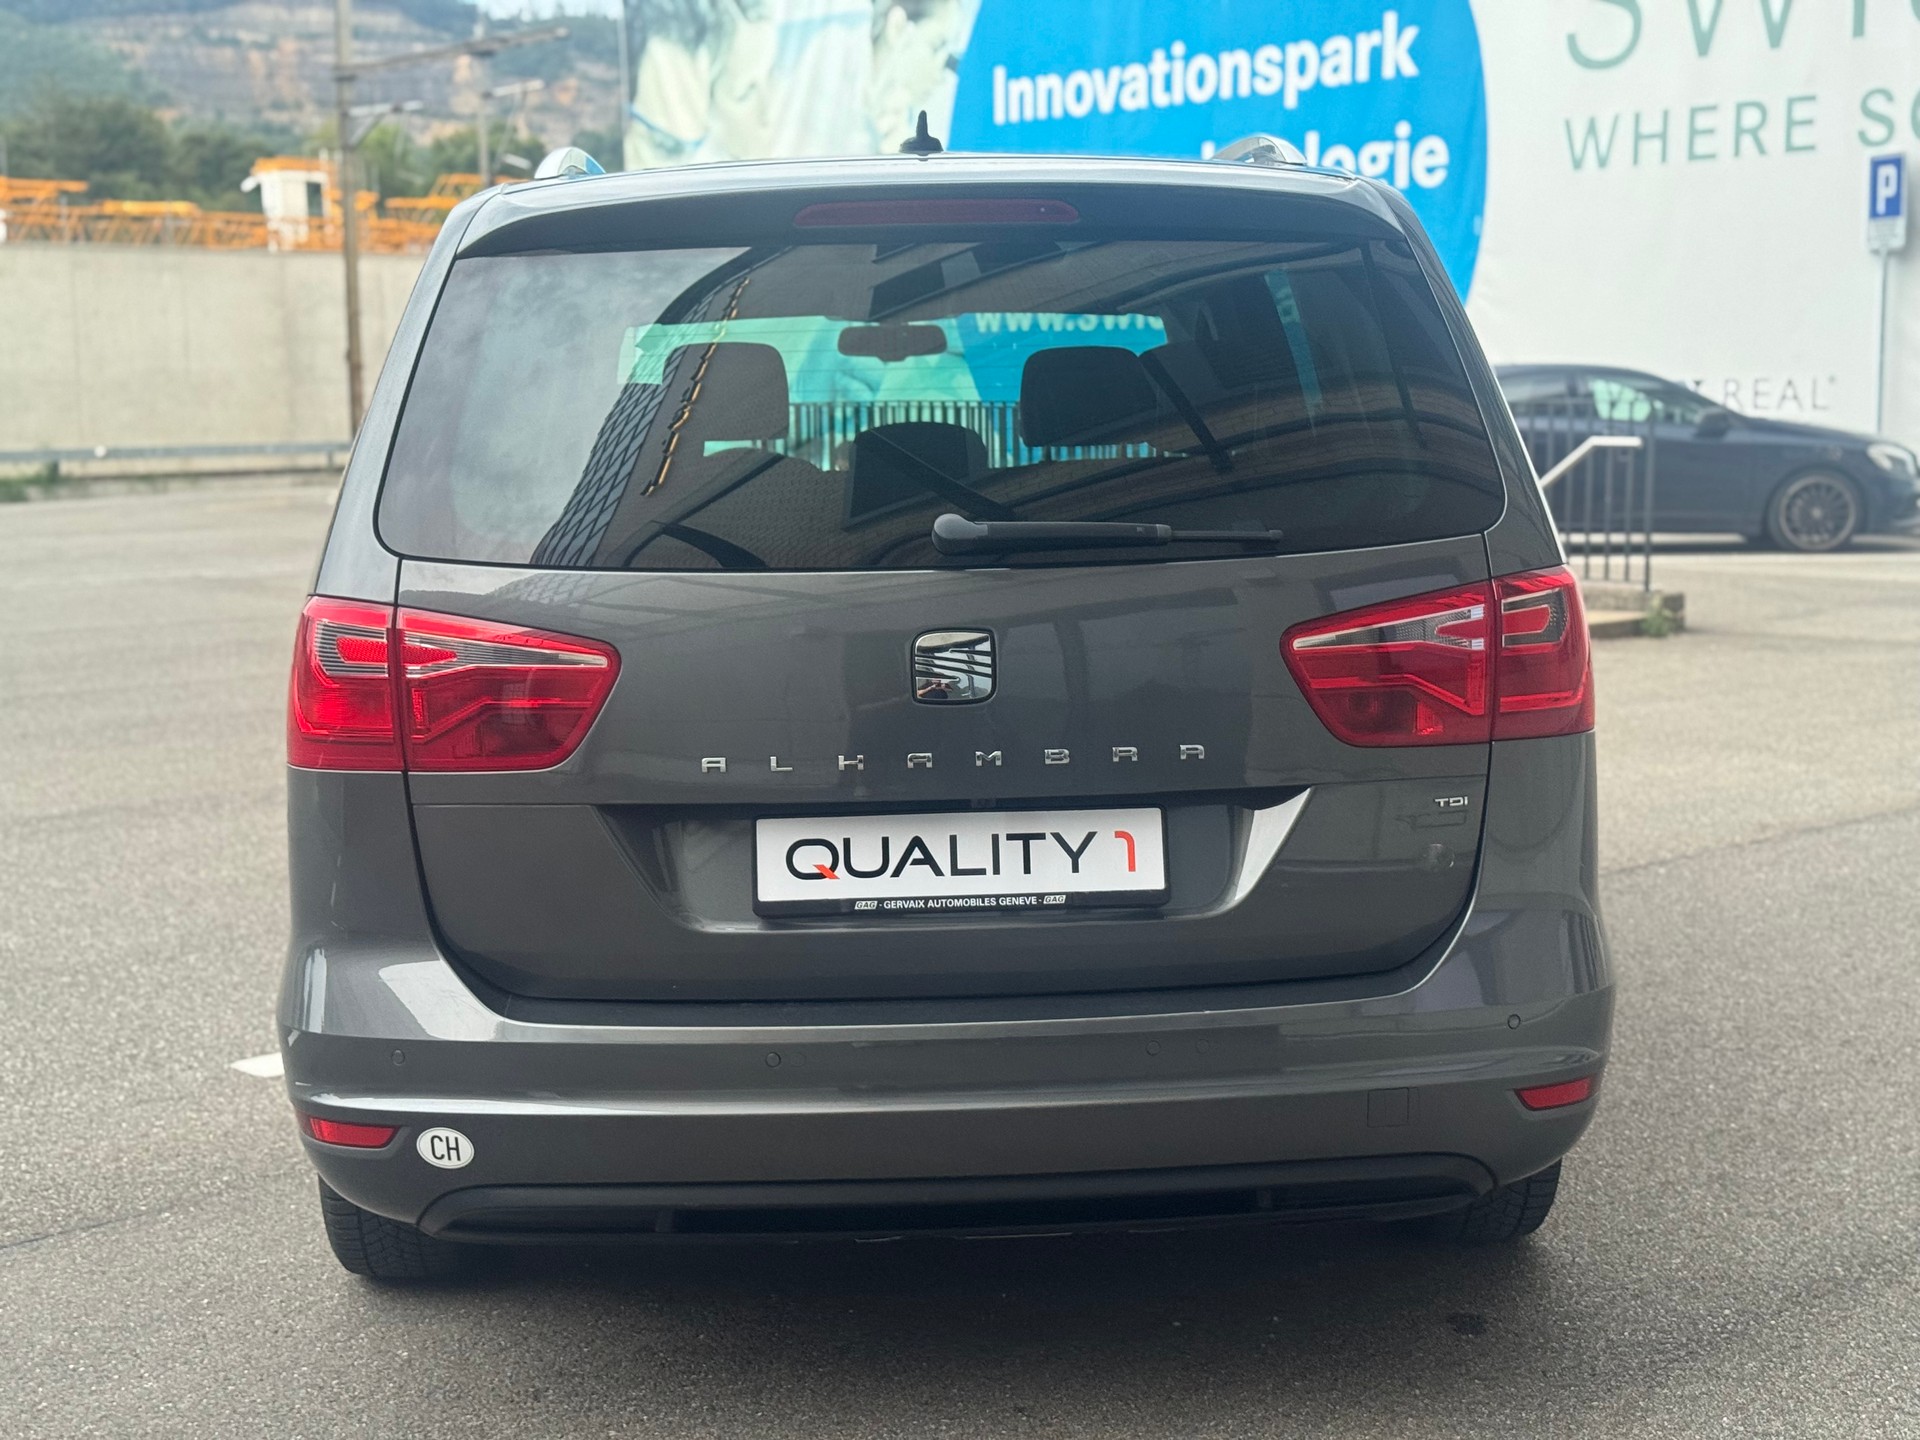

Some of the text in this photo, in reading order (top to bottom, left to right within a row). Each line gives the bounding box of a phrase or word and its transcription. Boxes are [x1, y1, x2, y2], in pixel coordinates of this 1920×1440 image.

[992, 10, 1419, 126] Innovationspark
[1565, 88, 1920, 171] WHERE S
[1876, 163, 1898, 215] P
[701, 743, 1205, 774] ALHAMBRA
[1434, 796, 1468, 808] TDI
[785, 831, 1136, 880] QUALITY 1
[883, 900, 925, 909] GERVAIX
[927, 897, 997, 909] AUTOMOBILES
[999, 896, 1037, 906] GENEVE
[430, 1135, 461, 1161] CH
